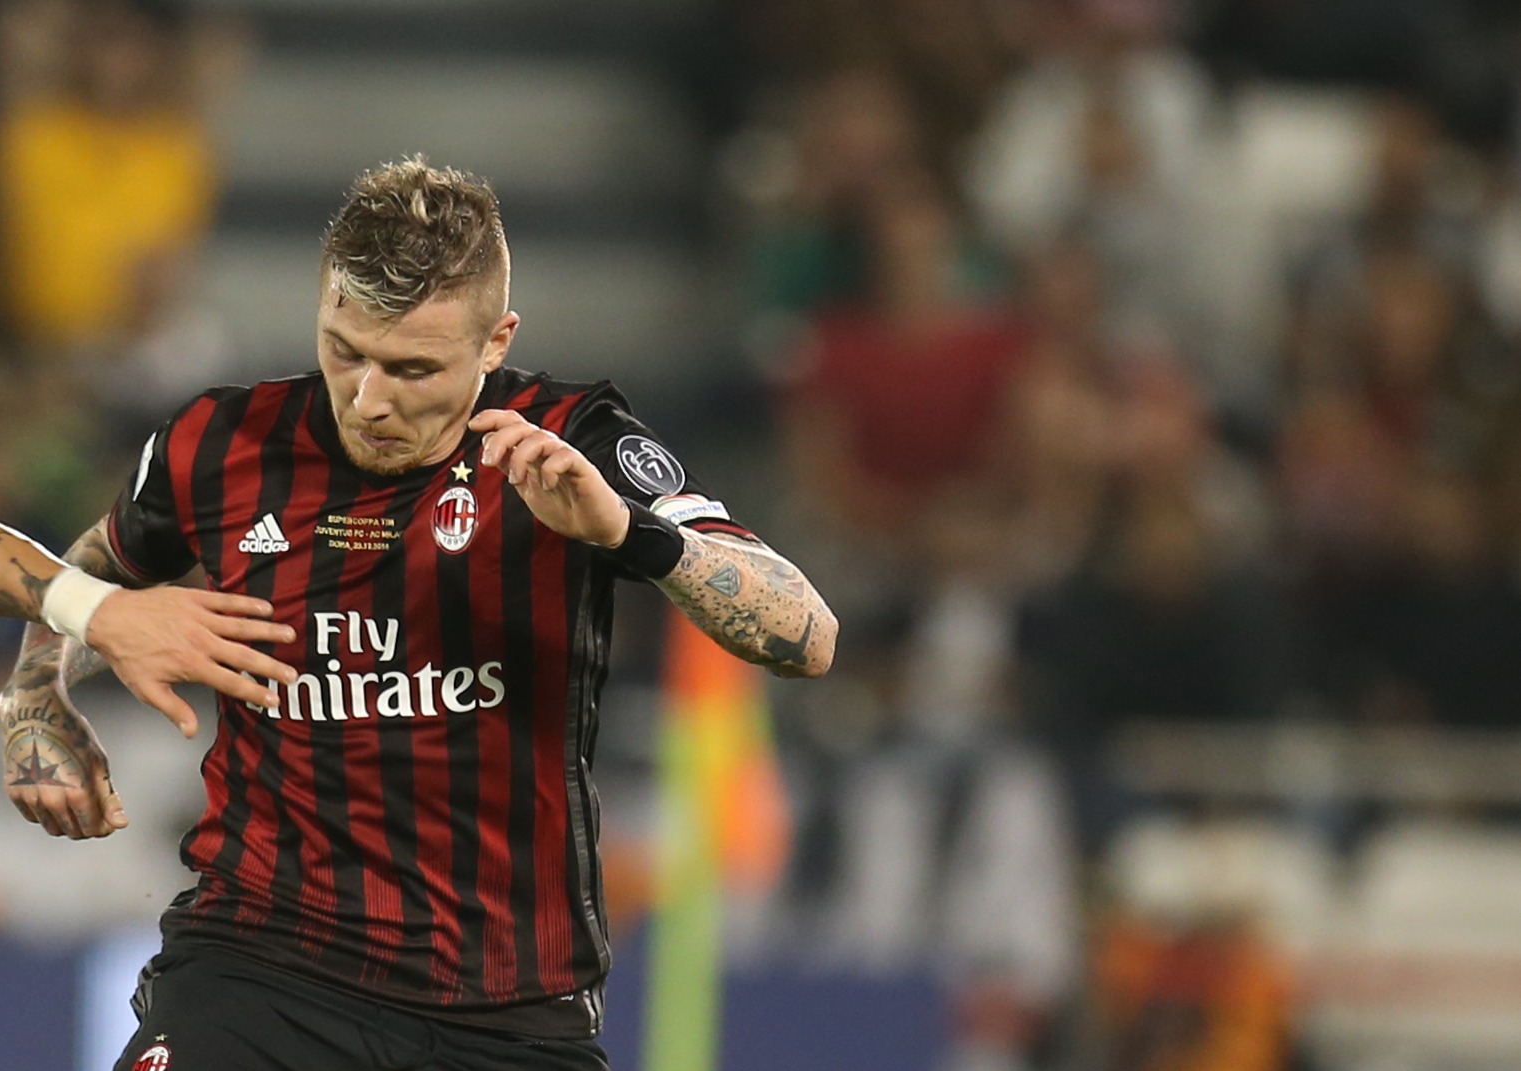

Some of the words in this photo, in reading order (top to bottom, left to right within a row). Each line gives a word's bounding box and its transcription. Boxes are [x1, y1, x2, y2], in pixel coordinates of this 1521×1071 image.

[647, 461, 663, 479] 7
[238, 537, 291, 554] adidas
[313, 610, 399, 662] Fly
